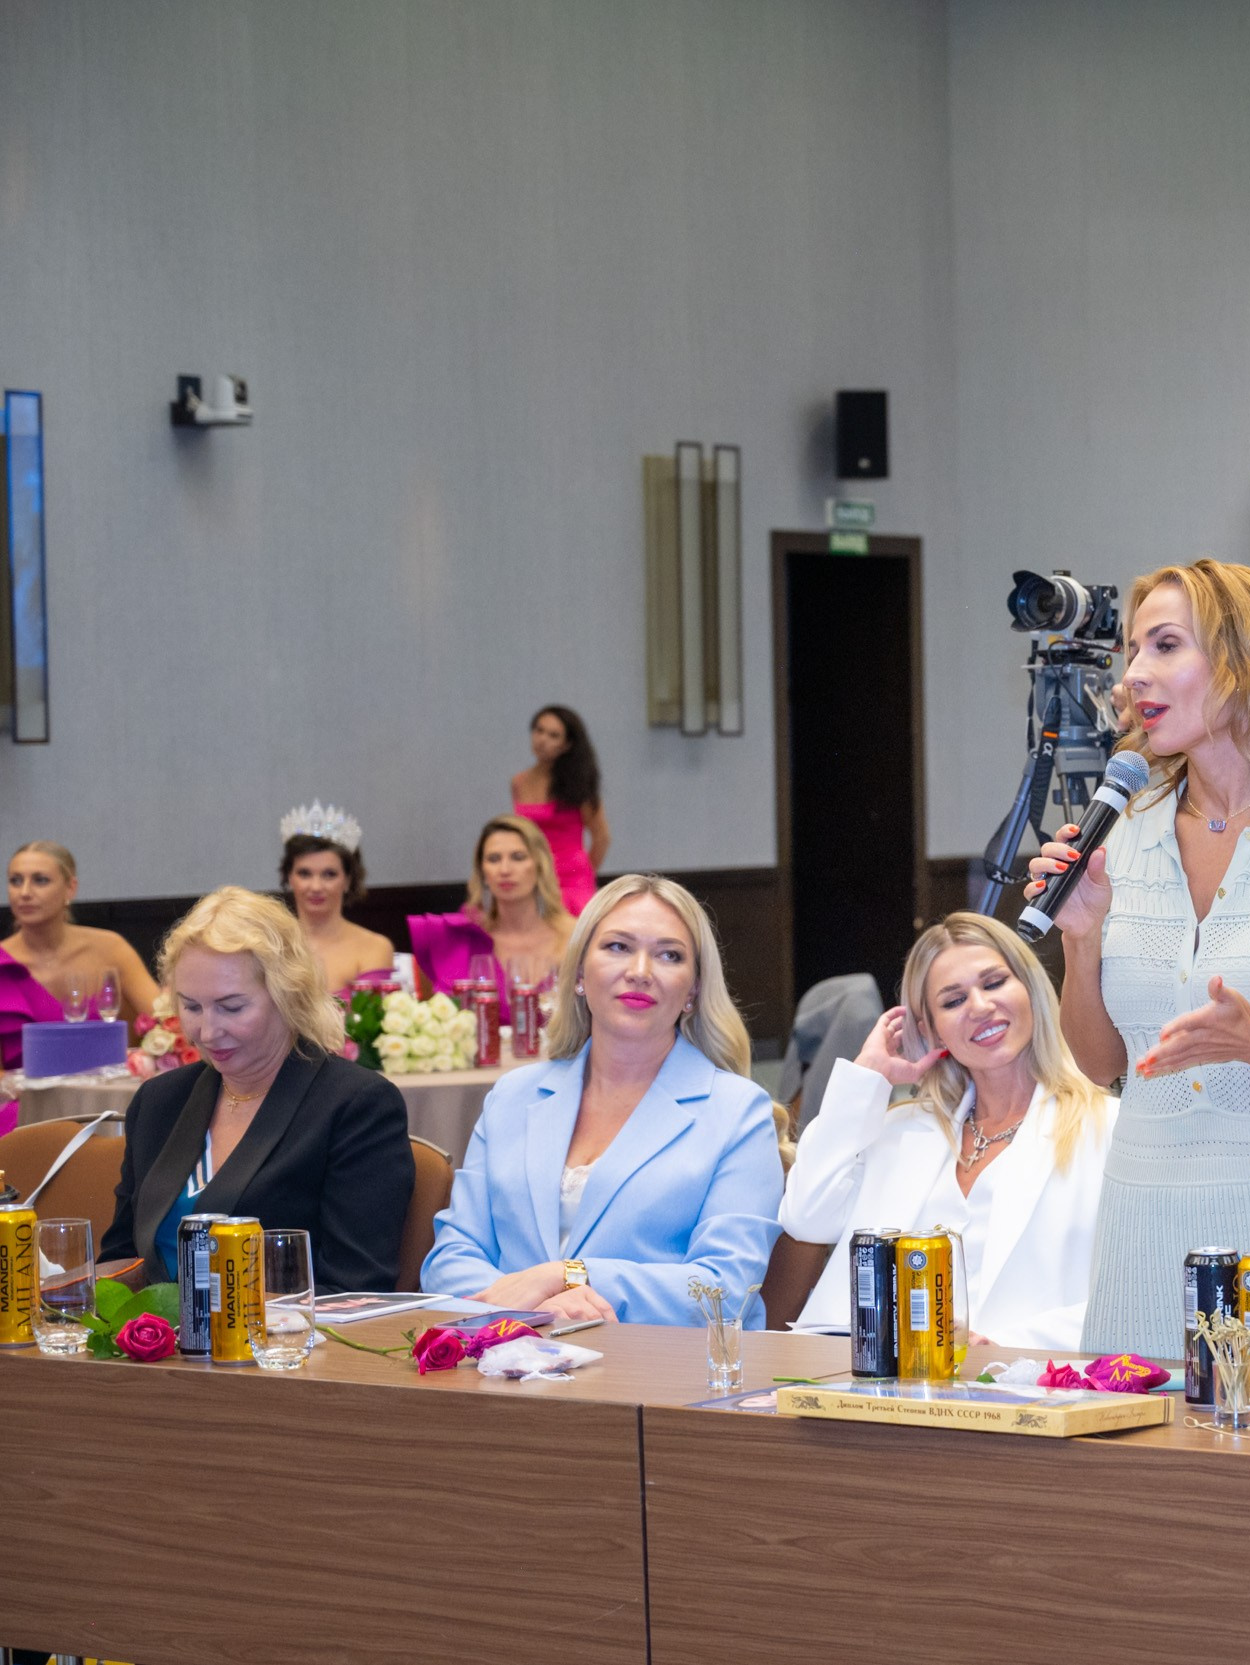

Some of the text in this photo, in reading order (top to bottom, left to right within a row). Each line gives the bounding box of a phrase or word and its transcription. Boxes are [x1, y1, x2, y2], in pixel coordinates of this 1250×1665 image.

[0, 1245, 9, 1313] MANGO
[15, 1223, 33, 1329] MILANO
[226, 1259, 235, 1329] MANGO
[242, 1237, 262, 1345] MILANO
[935, 1273, 944, 1347] MANGO
[837, 1399, 1001, 1421] Диплом Третьей Степени ВДНХ СССР 1968
